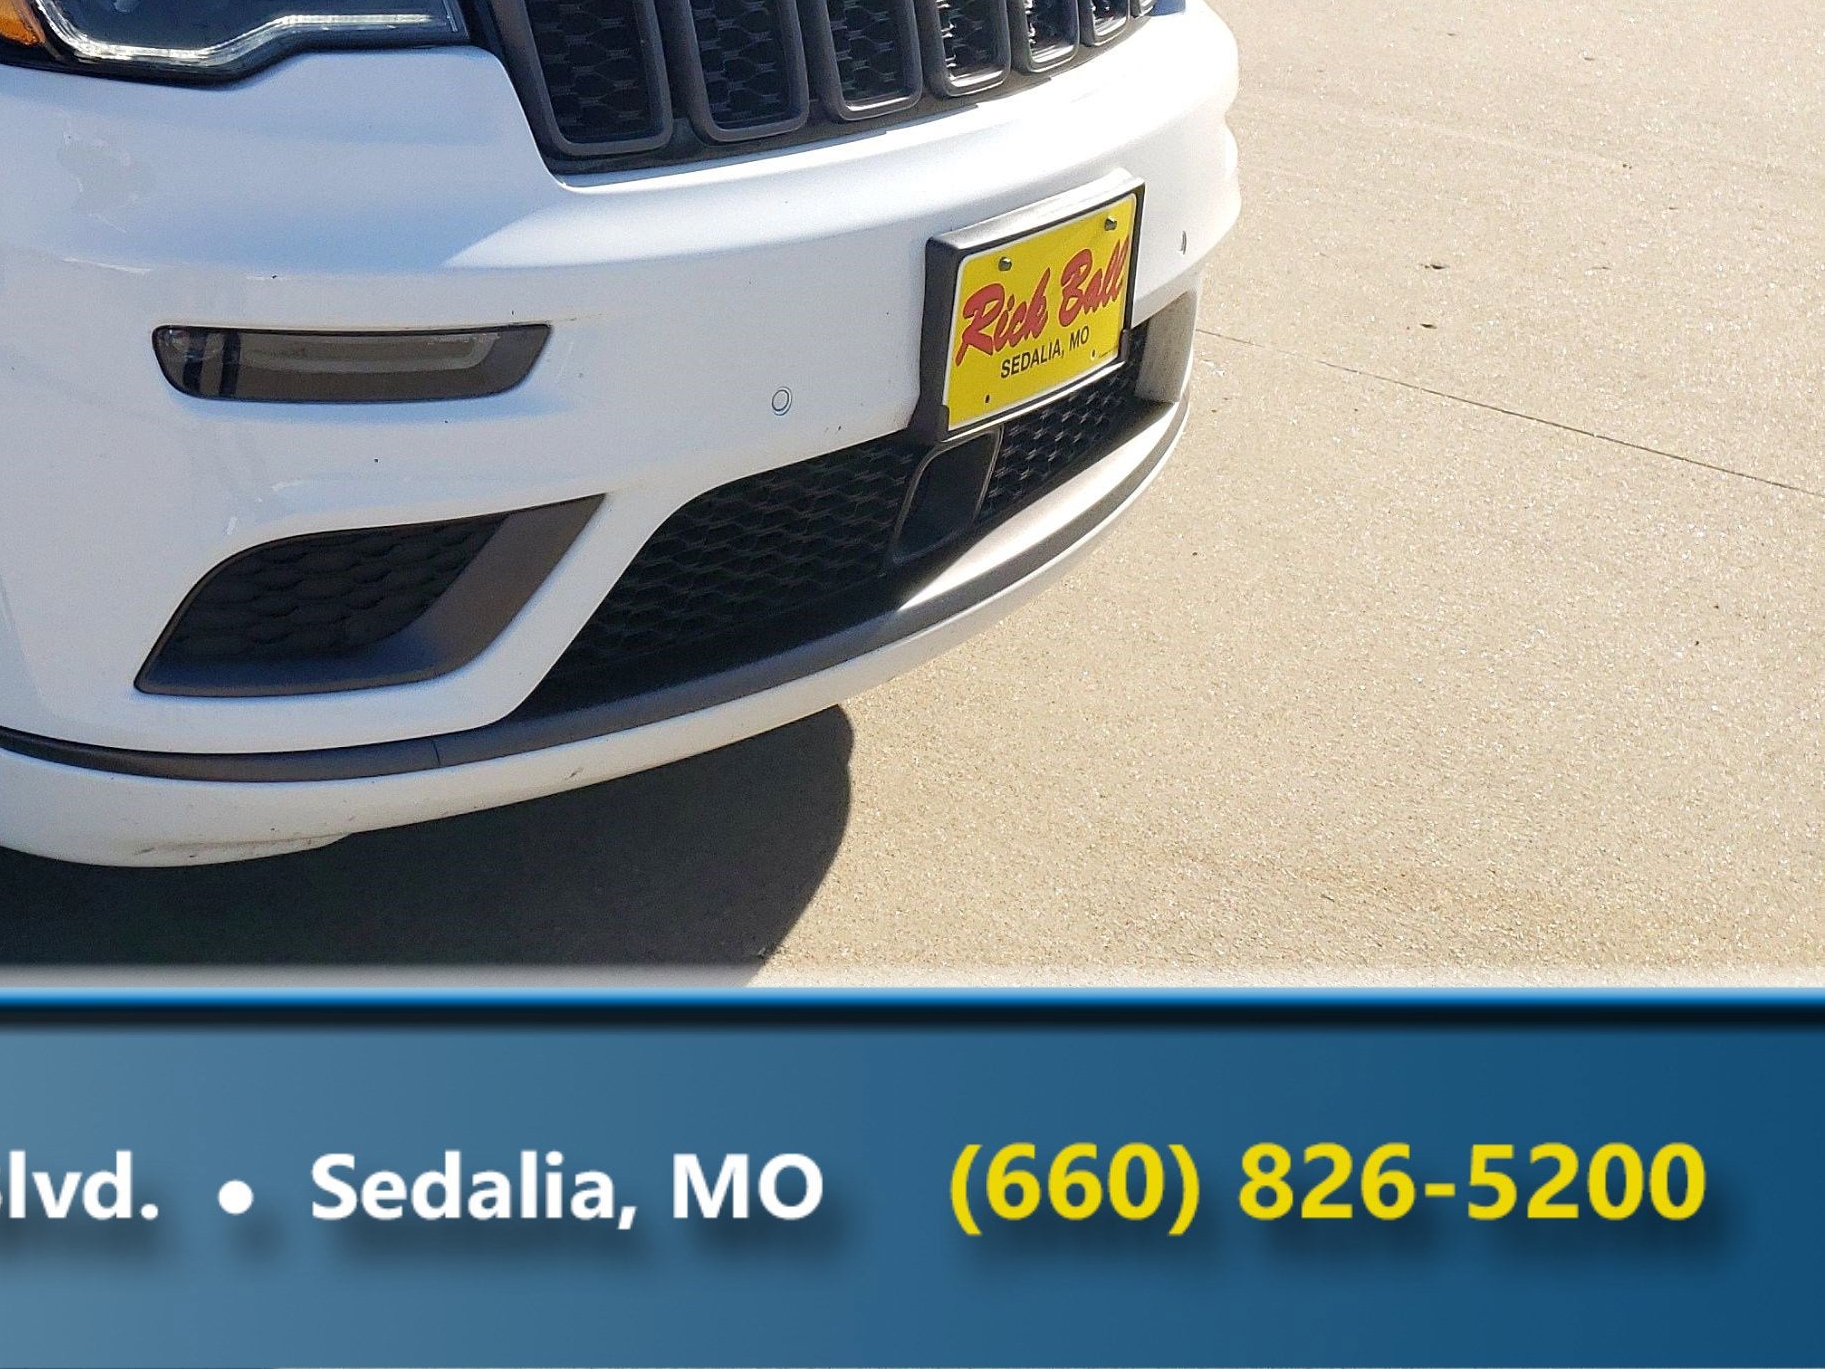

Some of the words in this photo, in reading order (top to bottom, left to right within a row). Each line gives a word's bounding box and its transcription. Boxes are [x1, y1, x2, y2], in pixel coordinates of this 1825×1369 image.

[955, 267, 1050, 366] Rick
[1058, 235, 1130, 327] Ball
[1000, 339, 1065, 379] SEDALIA,
[1069, 326, 1090, 352] MO
